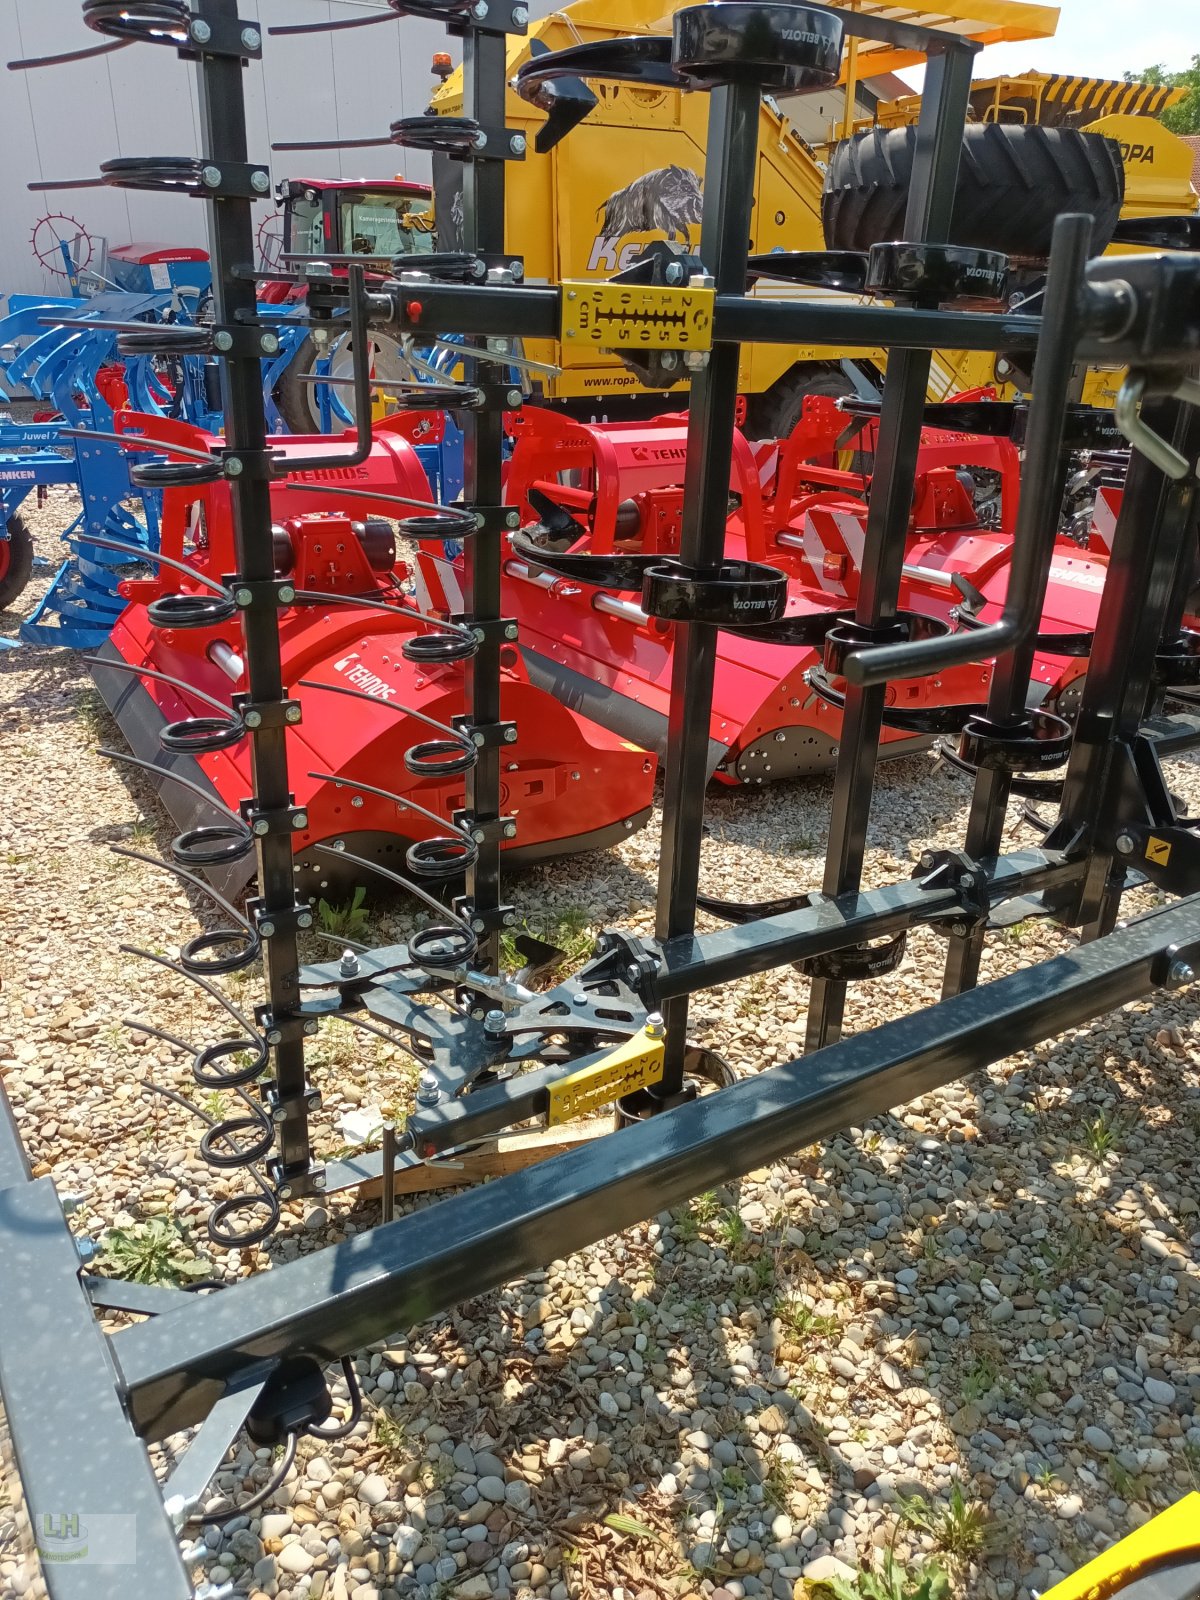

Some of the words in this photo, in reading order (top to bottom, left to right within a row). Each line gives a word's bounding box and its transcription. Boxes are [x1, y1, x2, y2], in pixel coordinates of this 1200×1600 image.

[782, 29, 819, 44] BELLOTA
[1120, 143, 1154, 163] OPA
[967, 268, 995, 280] BELLOTA
[579, 301, 588, 328] cm
[584, 377, 641, 387] www.ropa-
[22, 431, 50, 440] Juwel
[52, 431, 59, 440] 7
[734, 601, 766, 609] BELLOTA
